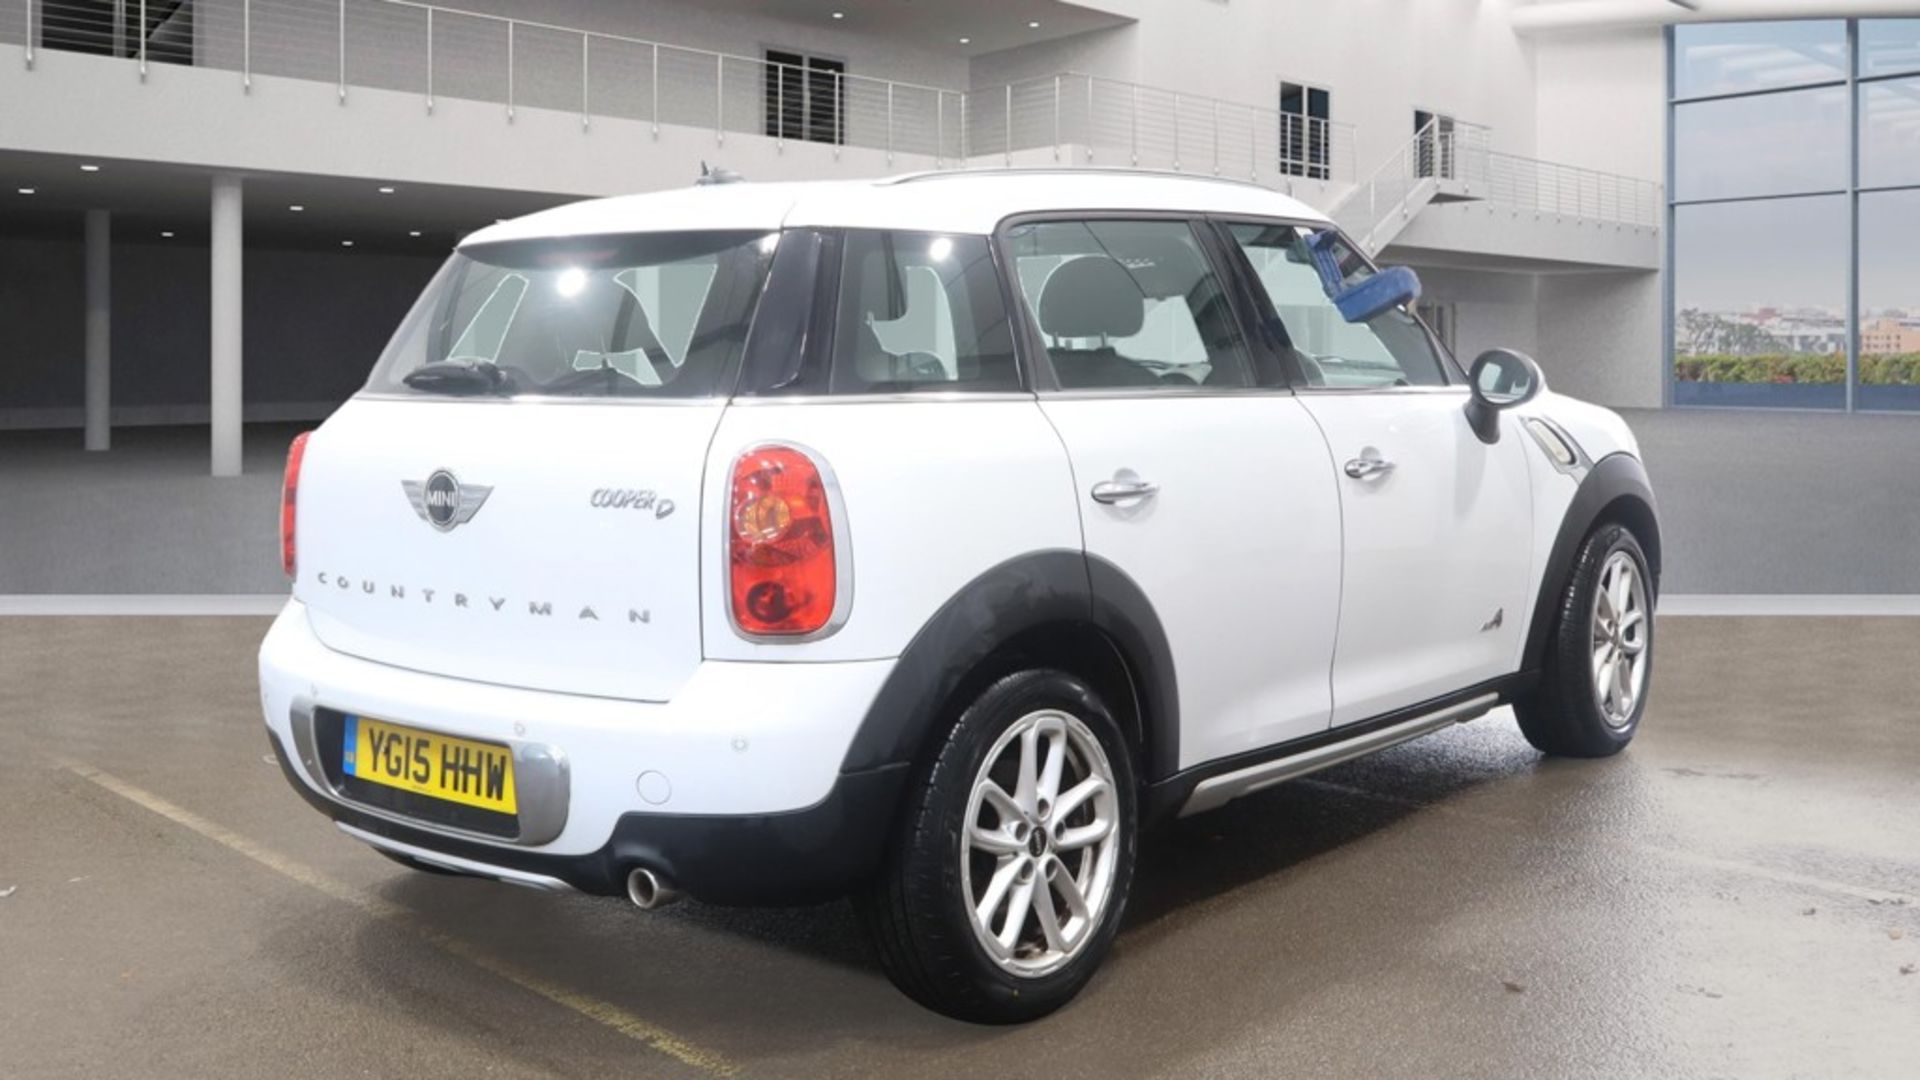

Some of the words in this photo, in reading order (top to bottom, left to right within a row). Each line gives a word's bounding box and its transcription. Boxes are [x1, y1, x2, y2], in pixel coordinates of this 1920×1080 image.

[428, 490, 455, 506] MINI
[590, 488, 657, 510] COOPER
[656, 498, 676, 521] D
[317, 572, 651, 624] COUNTRYMAN
[368, 727, 431, 784] YG15
[440, 743, 507, 801] HHW
